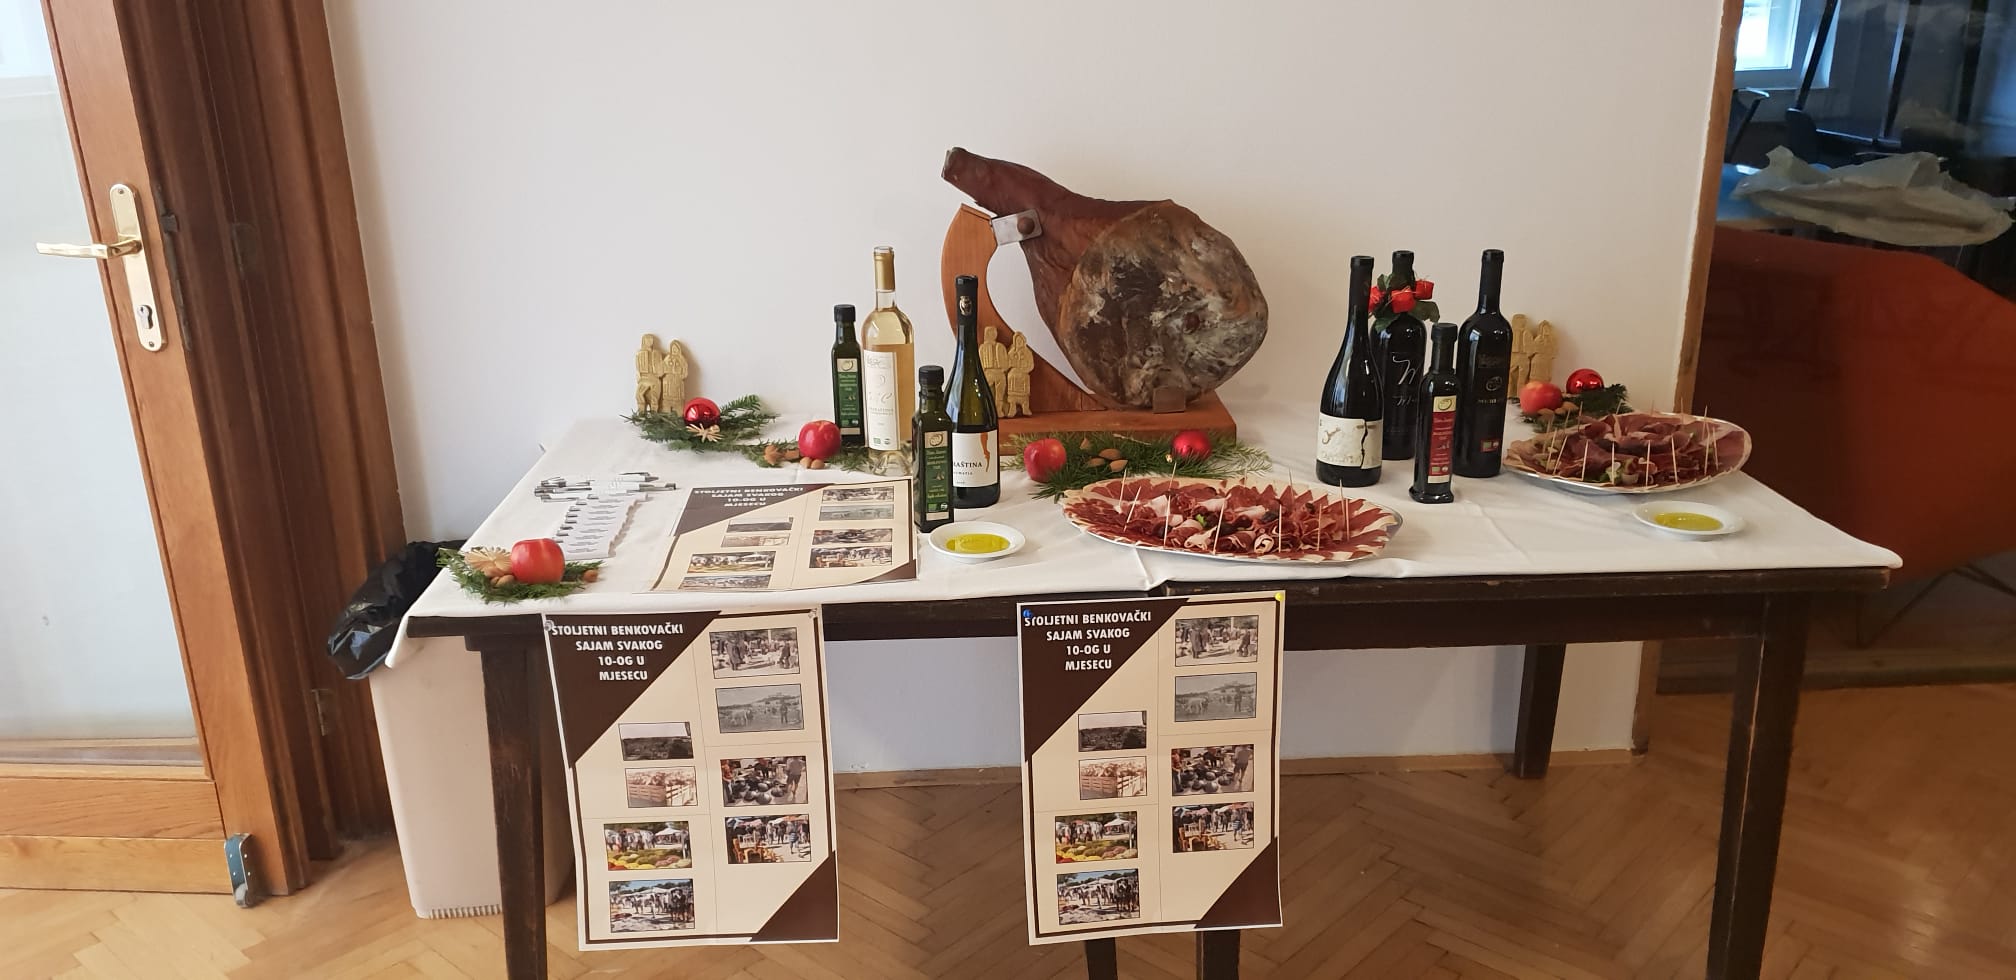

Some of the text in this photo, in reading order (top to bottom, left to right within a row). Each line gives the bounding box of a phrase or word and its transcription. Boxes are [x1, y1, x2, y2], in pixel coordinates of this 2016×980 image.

[1024, 609, 1151, 627] STOLJETNI BENKOVAČKI
[551, 621, 684, 636] STOLJETNI BENKOVAČKI
[1046, 627, 1130, 641] SAJAM SVAKOG
[575, 639, 663, 651] SAJAM SVAKOG
[1066, 644, 1111, 656] 10-OG U
[598, 655, 645, 666] 10-OG U
[1065, 659, 1112, 671] MJESECU
[599, 670, 648, 681] MJESECU
